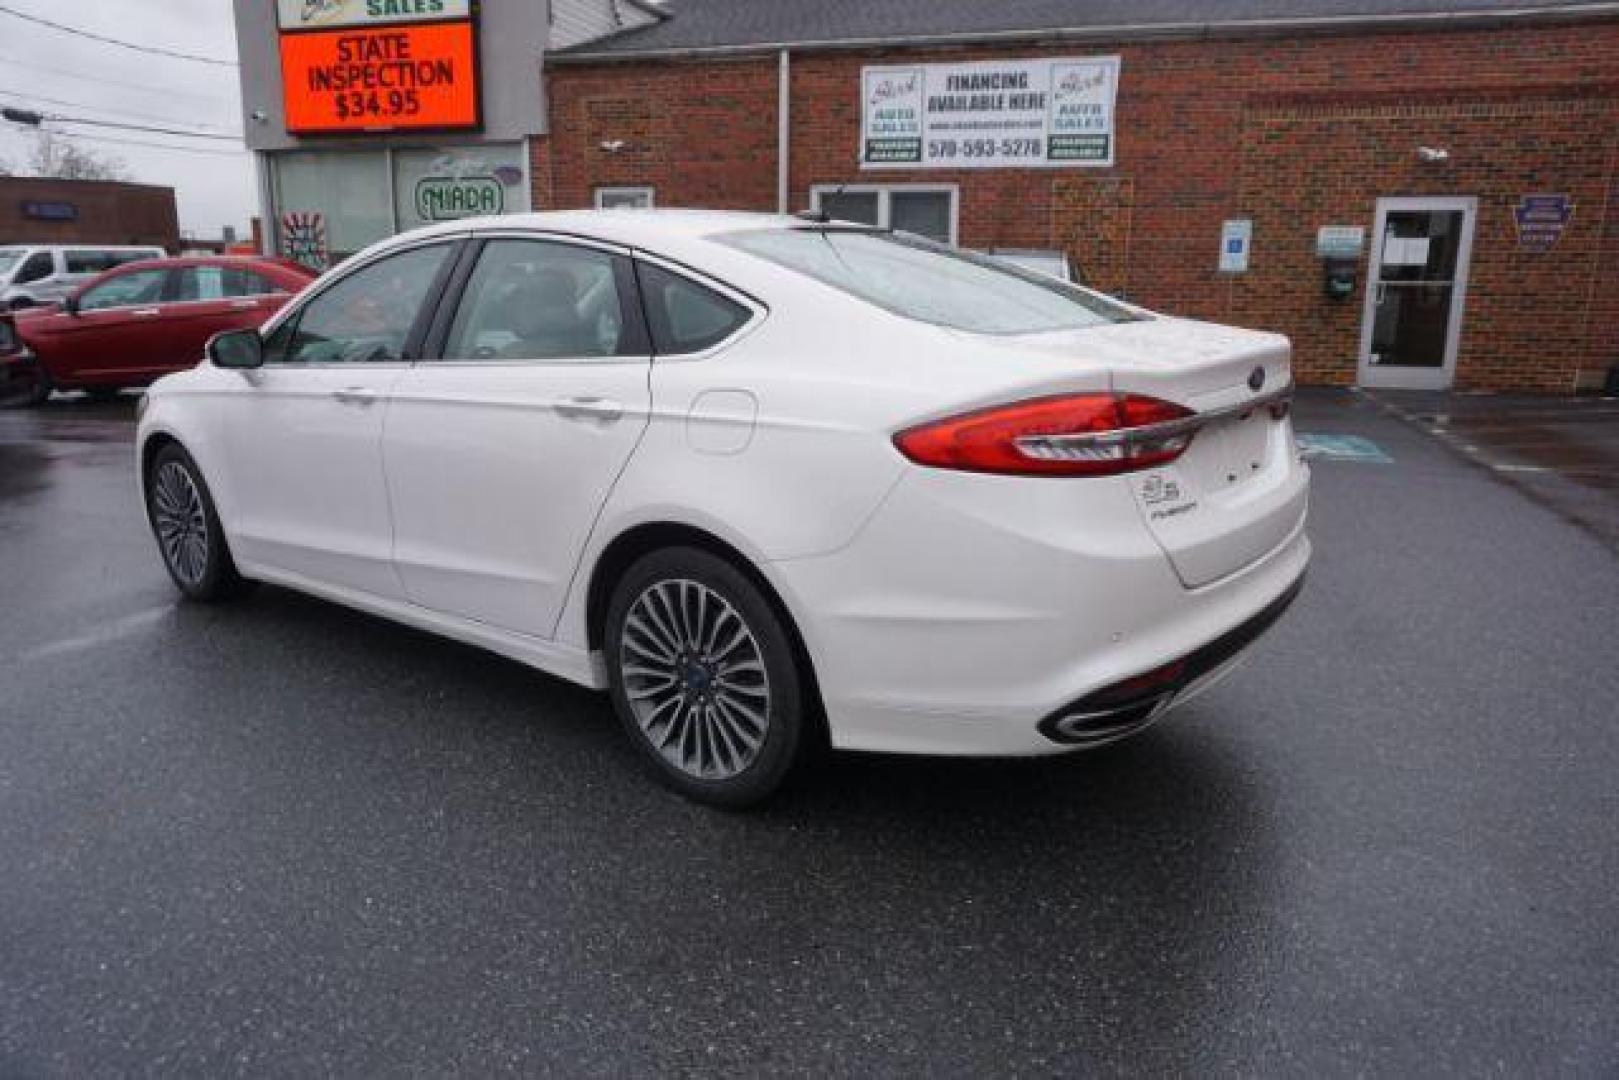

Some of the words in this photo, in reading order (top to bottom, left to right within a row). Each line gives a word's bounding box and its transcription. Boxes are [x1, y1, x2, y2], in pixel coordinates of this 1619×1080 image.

[366, 0, 444, 16] SALES
[336, 34, 410, 62] STATE
[308, 59, 454, 91] INSPECTION
[946, 72, 1028, 92] FINANCING
[336, 90, 420, 120] $34.95
[928, 94, 1003, 112] AVAILABLE
[1008, 91, 1046, 110] HERE
